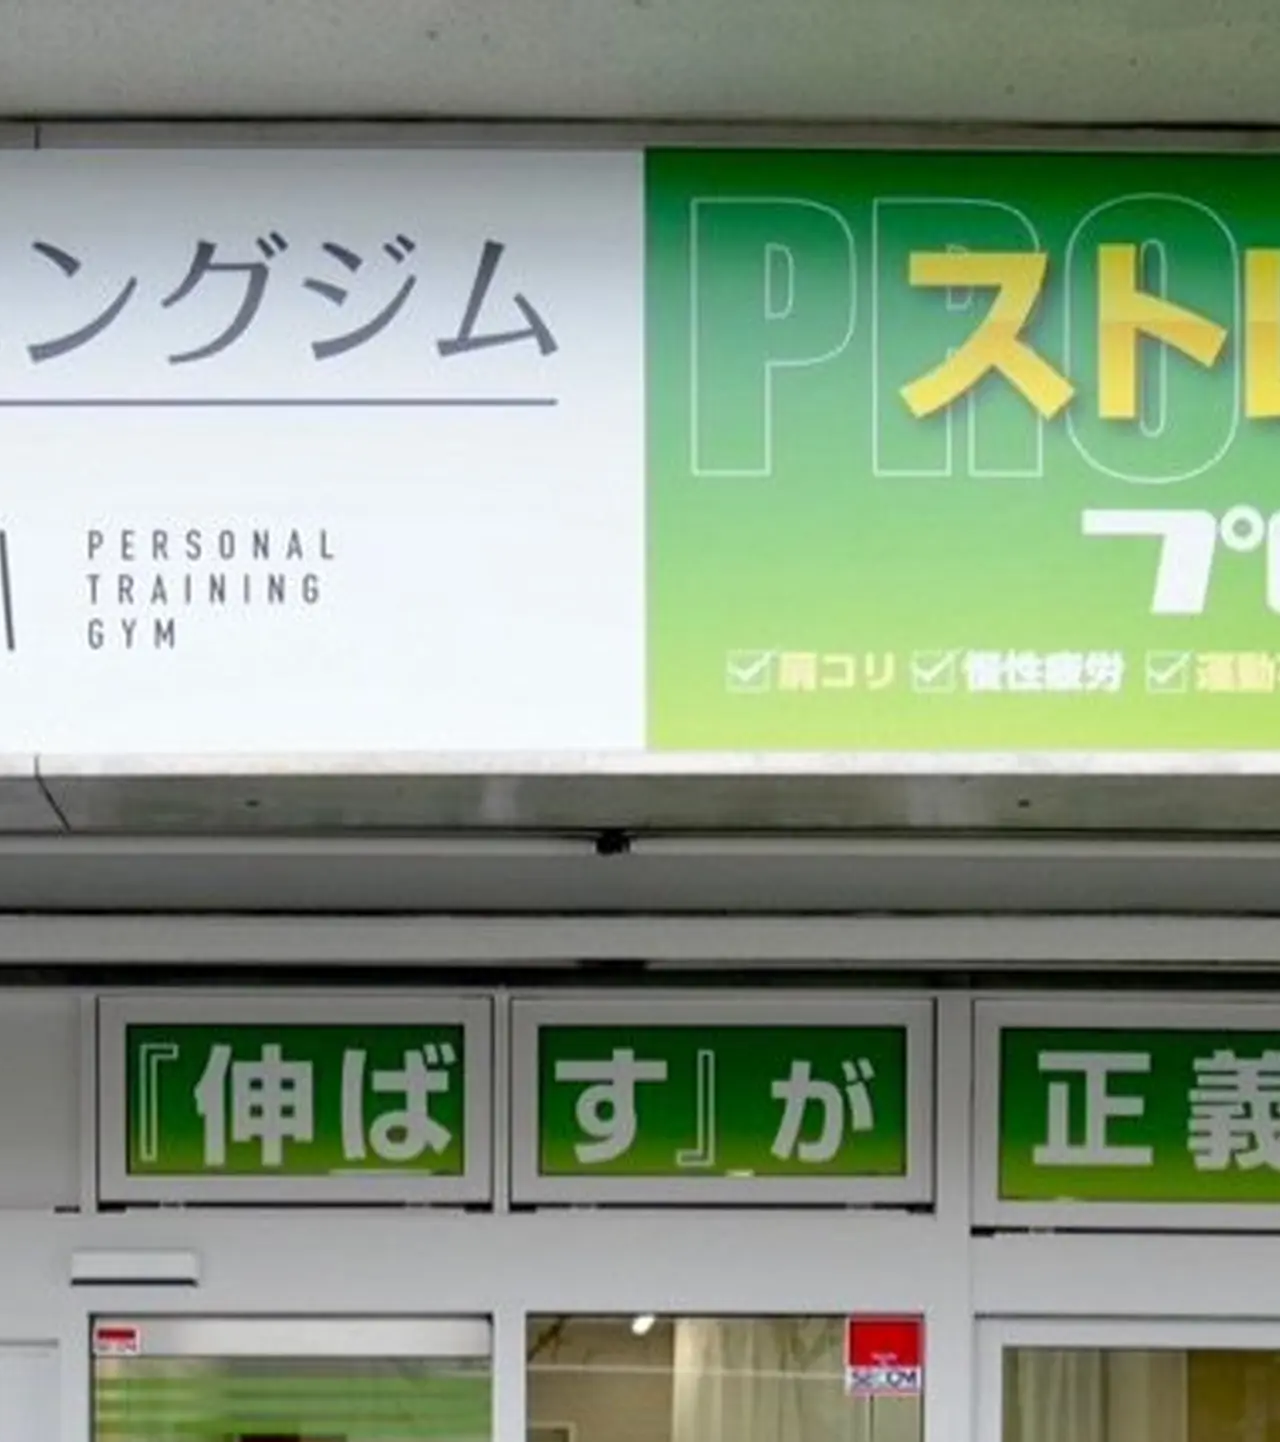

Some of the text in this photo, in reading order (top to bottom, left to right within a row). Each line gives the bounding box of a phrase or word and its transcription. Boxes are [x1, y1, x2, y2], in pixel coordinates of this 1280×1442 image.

[87, 529, 335, 563] PERSONAL
[87, 573, 322, 605] TRAINING
[87, 618, 178, 651] GYM
